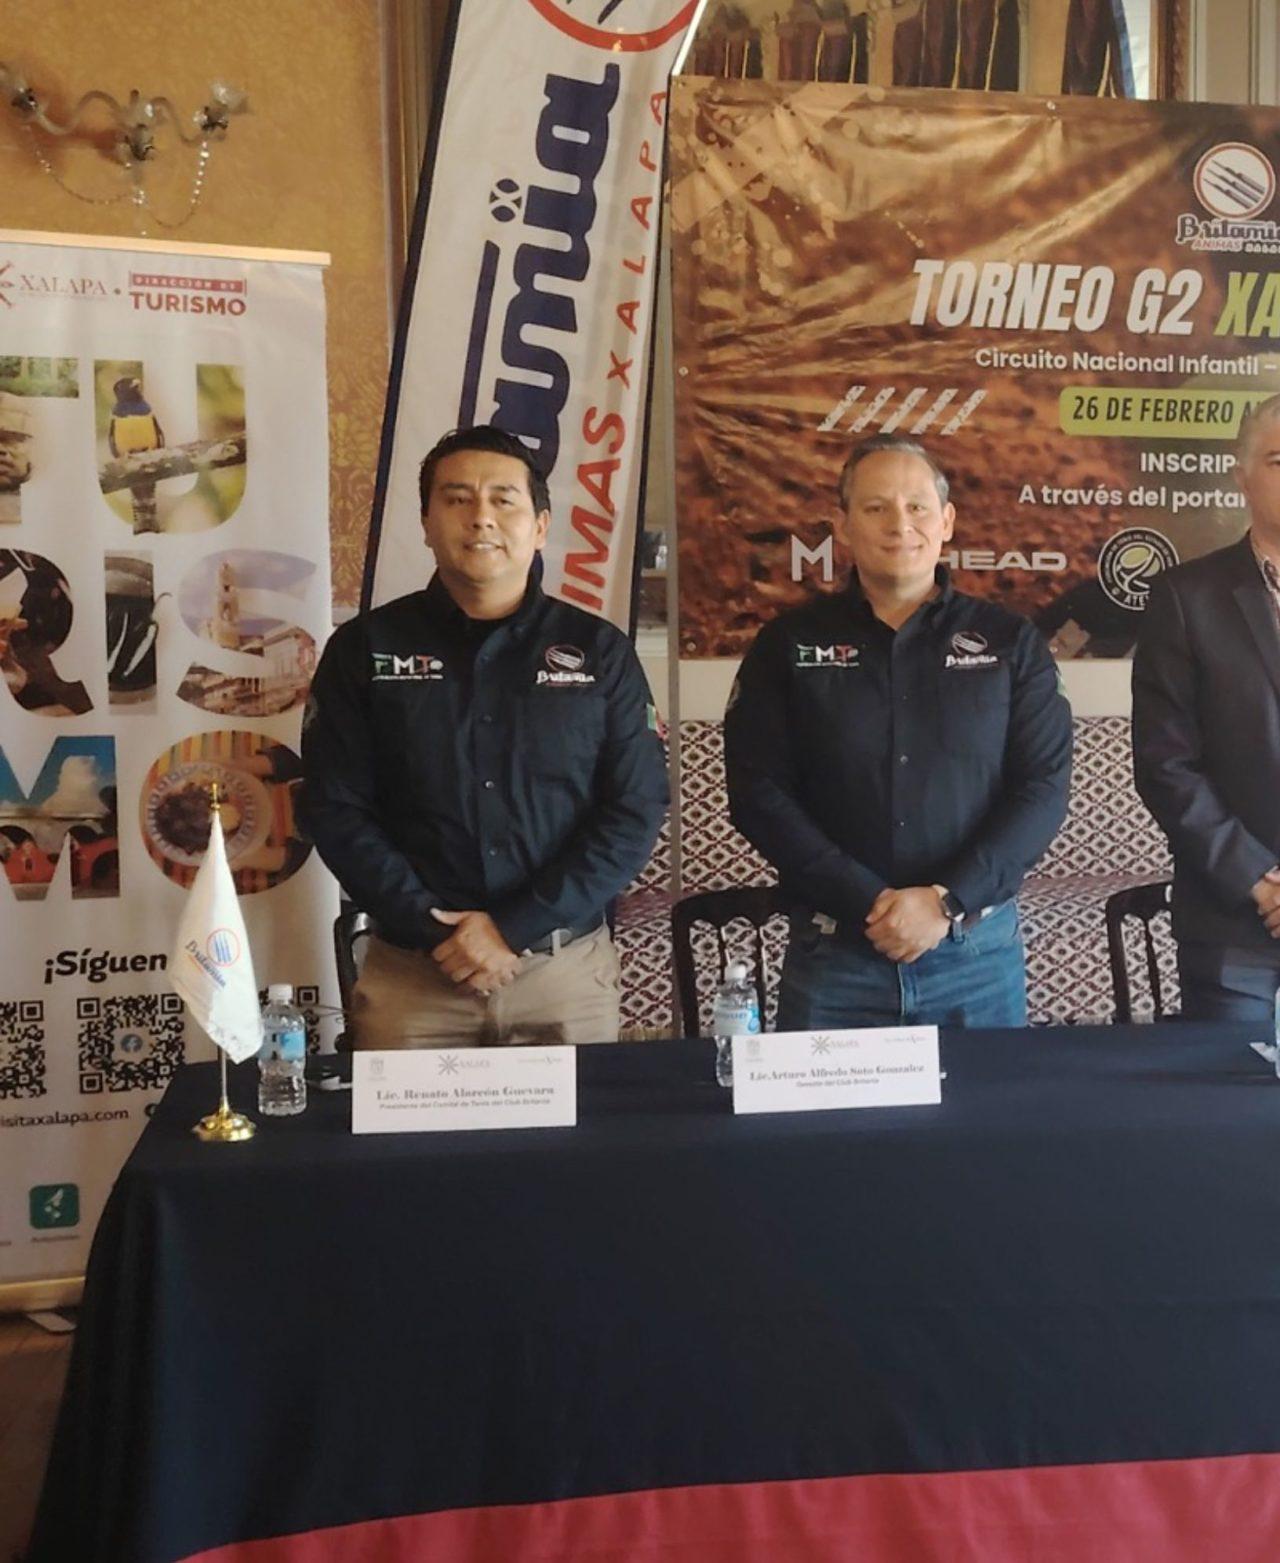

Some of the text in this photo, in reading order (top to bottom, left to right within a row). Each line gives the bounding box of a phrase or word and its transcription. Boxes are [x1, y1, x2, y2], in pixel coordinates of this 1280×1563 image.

[606, 90, 667, 390] XALAPA
[19, 273, 108, 296] XALAPA
[909, 259, 1115, 332] TORNEO
[1126, 268, 1204, 335] G2
[129, 291, 247, 317] TURISMO
[975, 348, 1069, 371] Circuito
[1073, 351, 1174, 374] Nacional
[1179, 353, 1259, 376] Infantil
[1073, 395, 1099, 421] 26
[1105, 396, 1133, 422] DE
[1139, 397, 1234, 424] FEBRERO
[1140, 453, 1239, 475] INSCRIP
[1018, 486, 1035, 505] A
[1041, 483, 1123, 508] través
[1128, 485, 1167, 508] del
[809, 1066, 848, 1079] Alfredo
[375, 1089, 400, 1101] Lic.
[404, 1088, 449, 1100] Renato
[503, 1084, 555, 1096] Guevara
